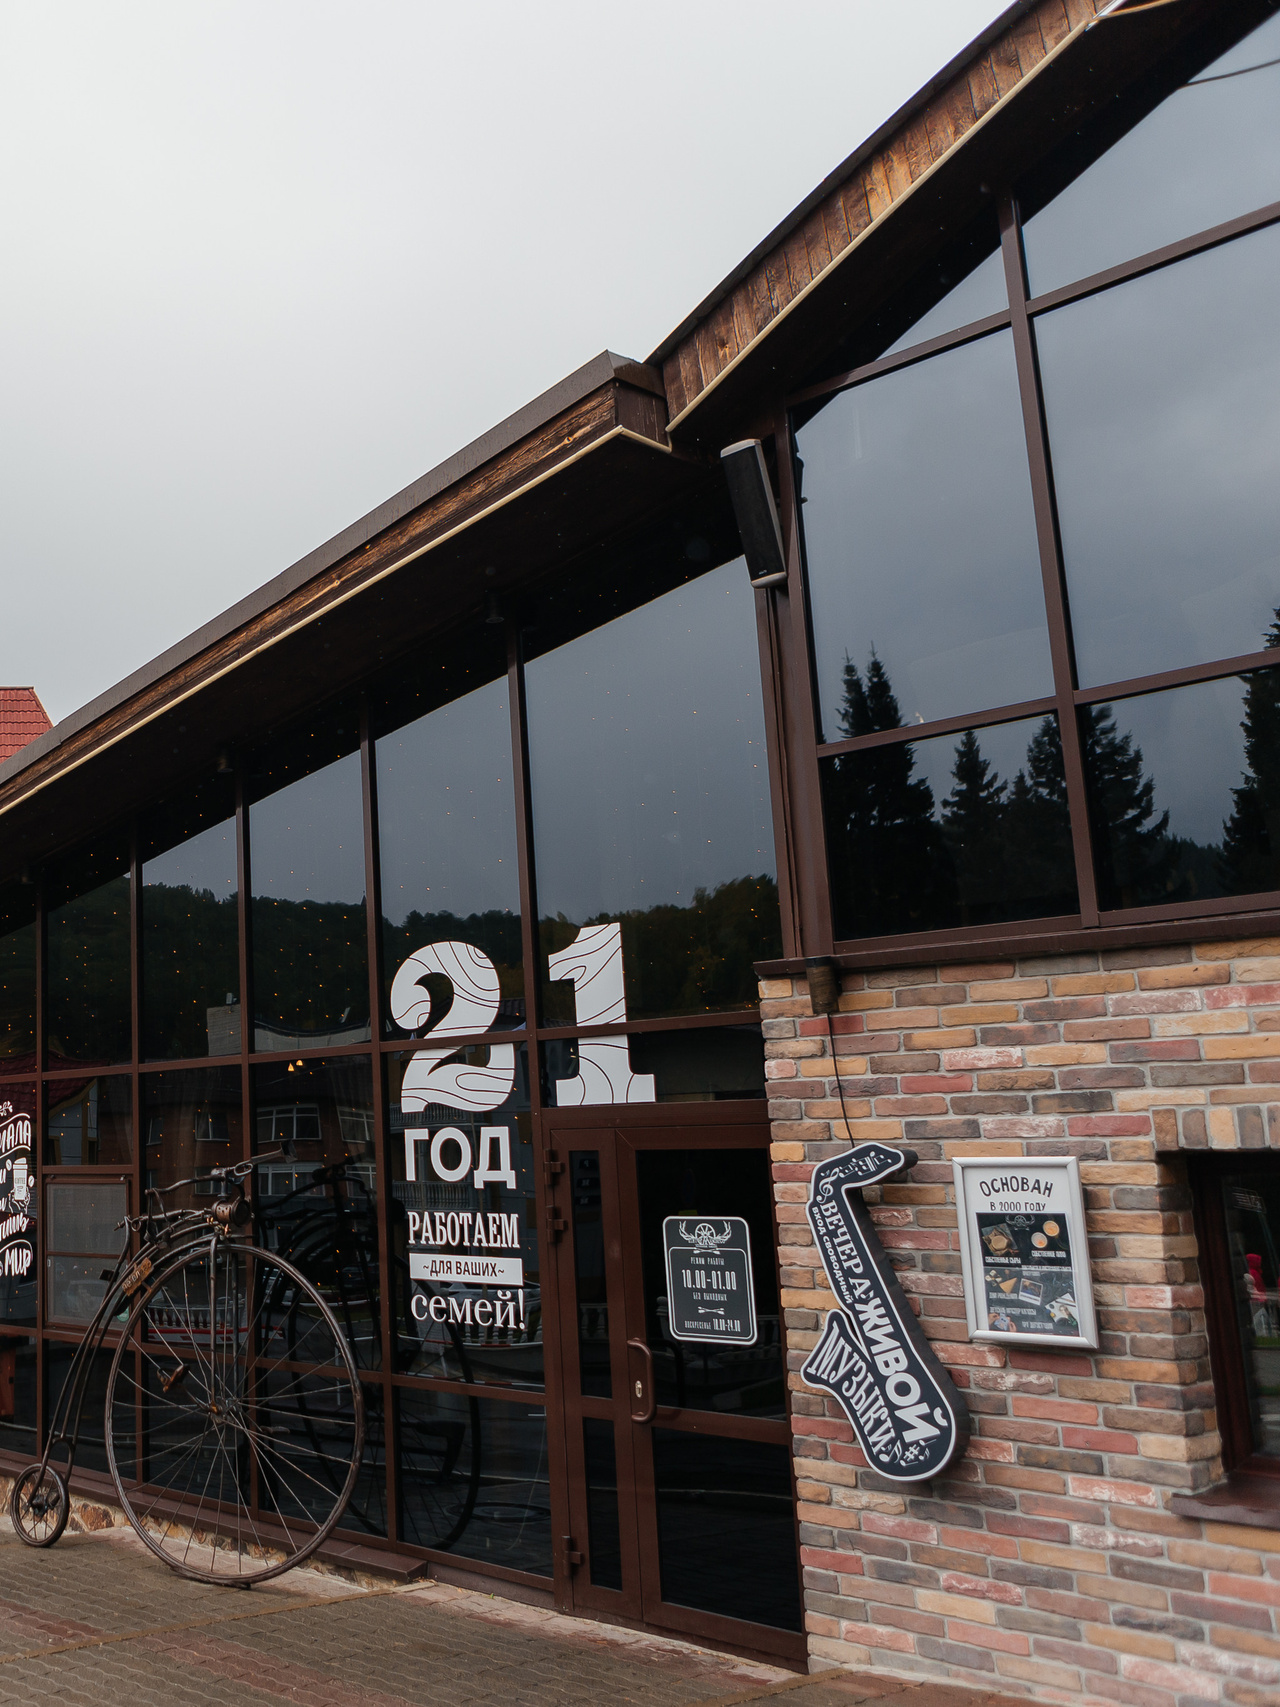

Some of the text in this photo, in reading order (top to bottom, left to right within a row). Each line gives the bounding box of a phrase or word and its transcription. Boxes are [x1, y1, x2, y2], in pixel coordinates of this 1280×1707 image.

[390, 922, 656, 1113] 21
[404, 1126, 516, 1189] ГОД
[979, 1175, 1053, 1198] ОСНОВАН
[989, 1201, 997, 1212] В
[999, 1201, 1021, 1212] 2000
[408, 1211, 520, 1248] РАБОТАЕМ
[4, 1247, 31, 1277] МИР
[811, 1206, 854, 1304] ВХОД СВОБОДНЫЙ
[681, 1269, 737, 1290] 10.00-01.00
[410, 1288, 526, 1330] семей!
[820, 1200, 949, 1444] ВЕЧЕРА ЖИВОЙ
[806, 1320, 895, 1455] МУЗЫКИ
